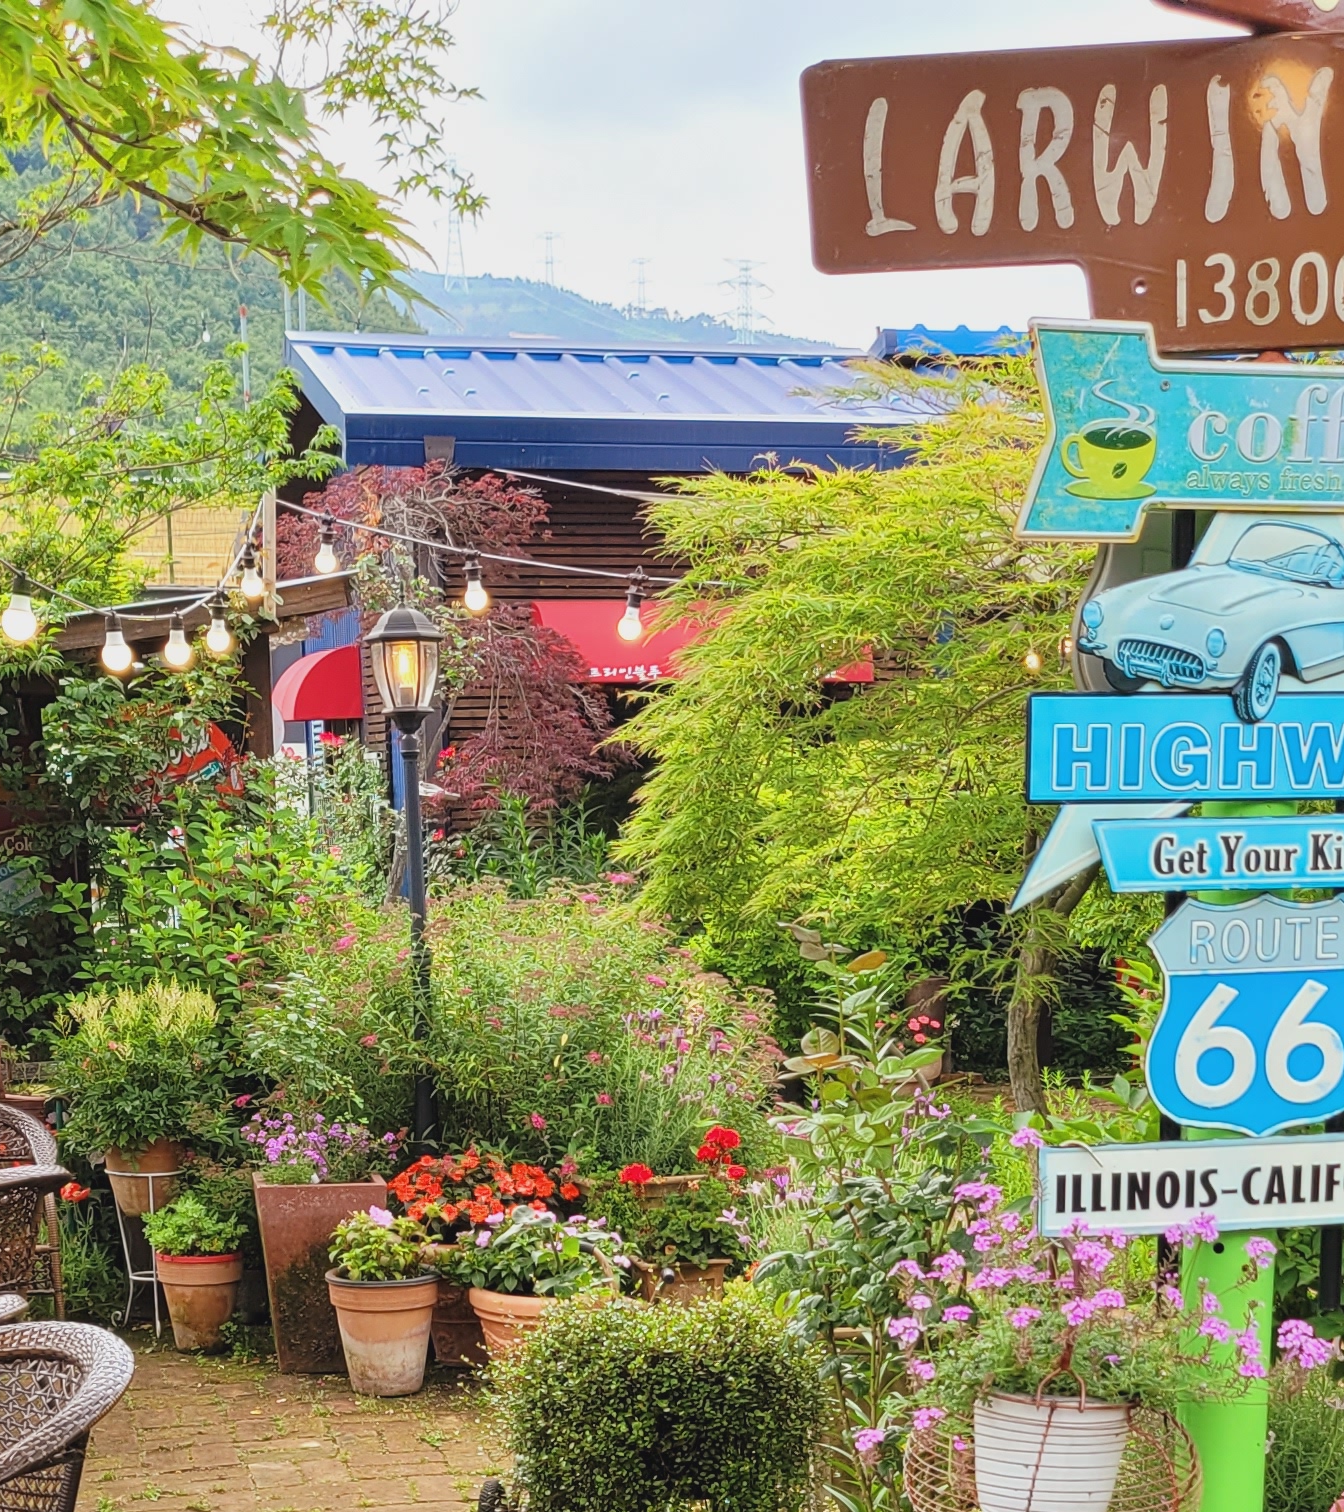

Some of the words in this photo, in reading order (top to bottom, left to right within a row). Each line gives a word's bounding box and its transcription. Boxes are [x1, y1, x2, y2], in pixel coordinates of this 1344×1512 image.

[862, 66, 1335, 237] LARWIN
[1186, 465, 1271, 496] always
[1279, 465, 1342, 492] fresh
[3, 835, 44, 852] Cok
[1153, 836, 1208, 876] Get
[1220, 834, 1299, 874] Your
[1189, 914, 1340, 965] ROUTE
